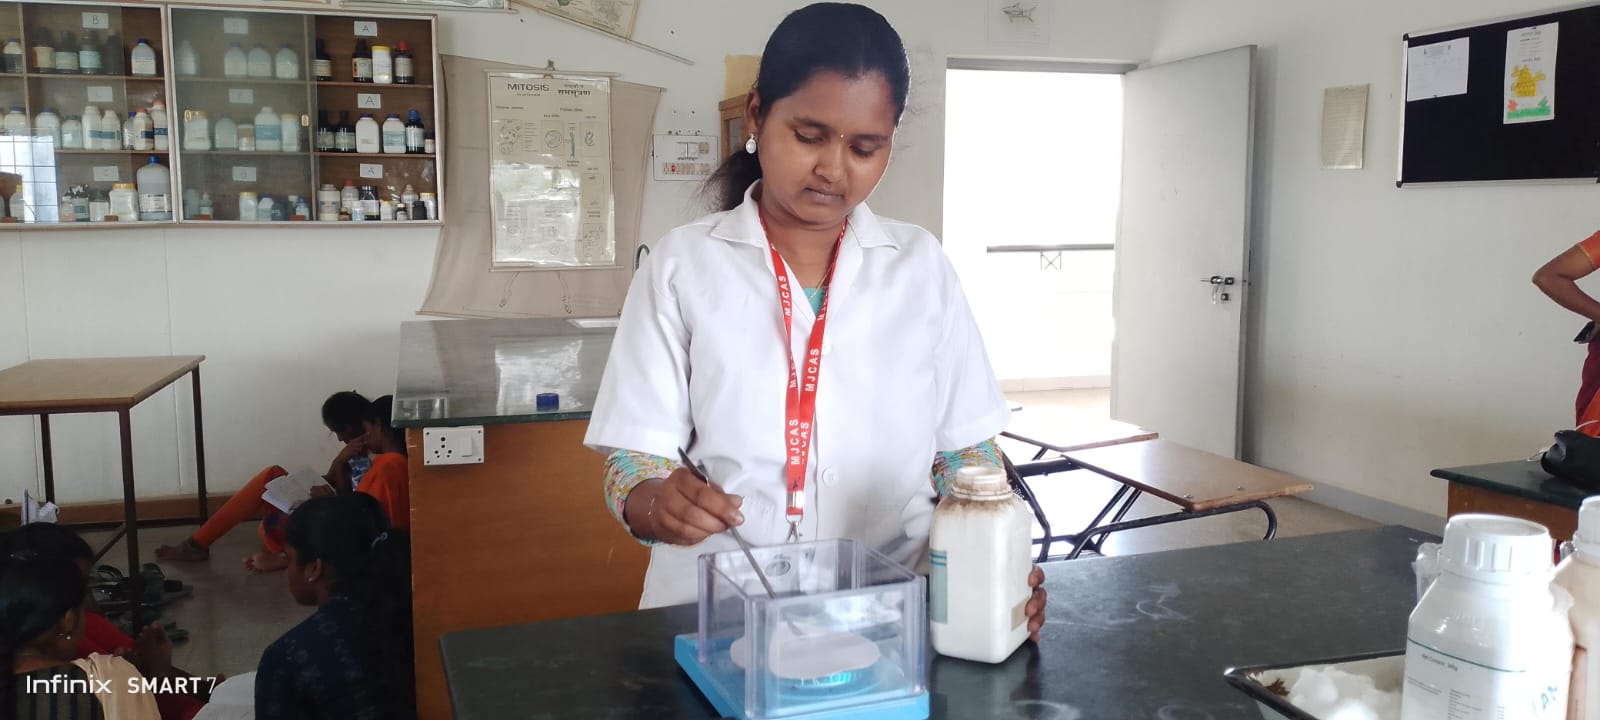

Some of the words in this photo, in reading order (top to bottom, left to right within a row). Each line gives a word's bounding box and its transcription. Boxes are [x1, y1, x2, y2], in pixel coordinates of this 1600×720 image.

[362, 24, 370, 33] A
[365, 95, 375, 105] A
[507, 83, 550, 92] MITOSIS
[778, 275, 792, 317] MJCAS
[804, 348, 820, 392] MJCAS
[789, 419, 800, 465] MJCAS
